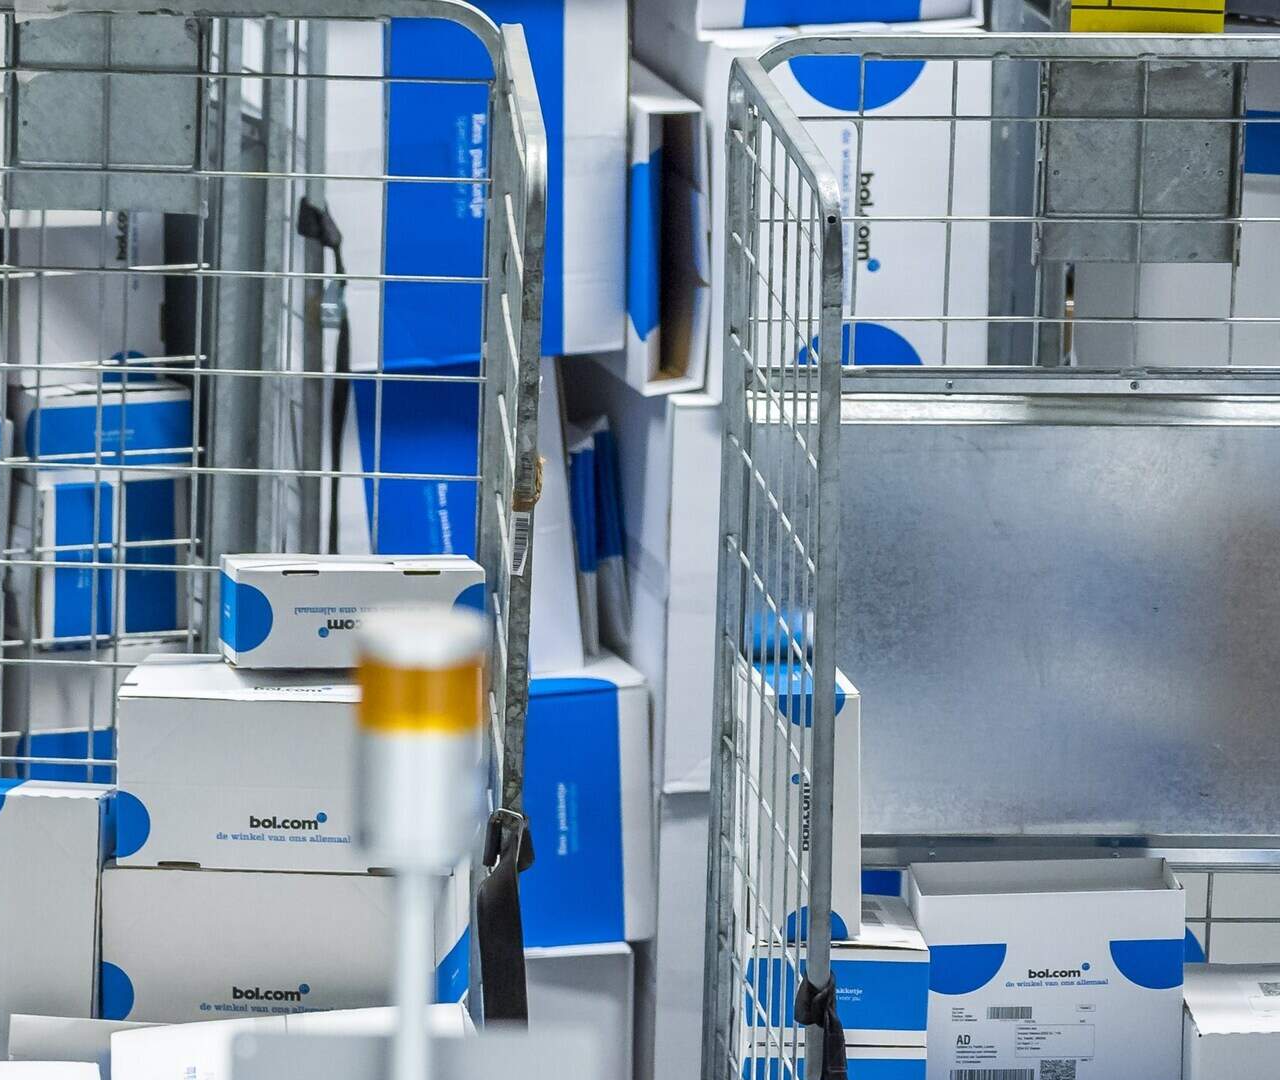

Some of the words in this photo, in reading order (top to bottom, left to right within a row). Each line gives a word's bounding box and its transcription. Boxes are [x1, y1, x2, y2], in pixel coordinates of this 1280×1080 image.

[249, 815, 318, 830] bol.com
[216, 831, 229, 841] de
[231, 832, 265, 842] winkel
[267, 834, 286, 842] van
[288, 834, 307, 843] ons
[309, 834, 352, 844] allemaal
[1028, 969, 1081, 979] bol.com
[1016, 980, 1043, 988] winkel
[1076, 978, 1109, 986] allemaal
[232, 986, 301, 1002] bol.com
[835, 987, 863, 996] akketje
[199, 1002, 212, 1011] de
[214, 1003, 248, 1012] winkel
[250, 1004, 269, 1013] van
[271, 1005, 290, 1014] ons
[956, 1034, 971, 1046] AD
